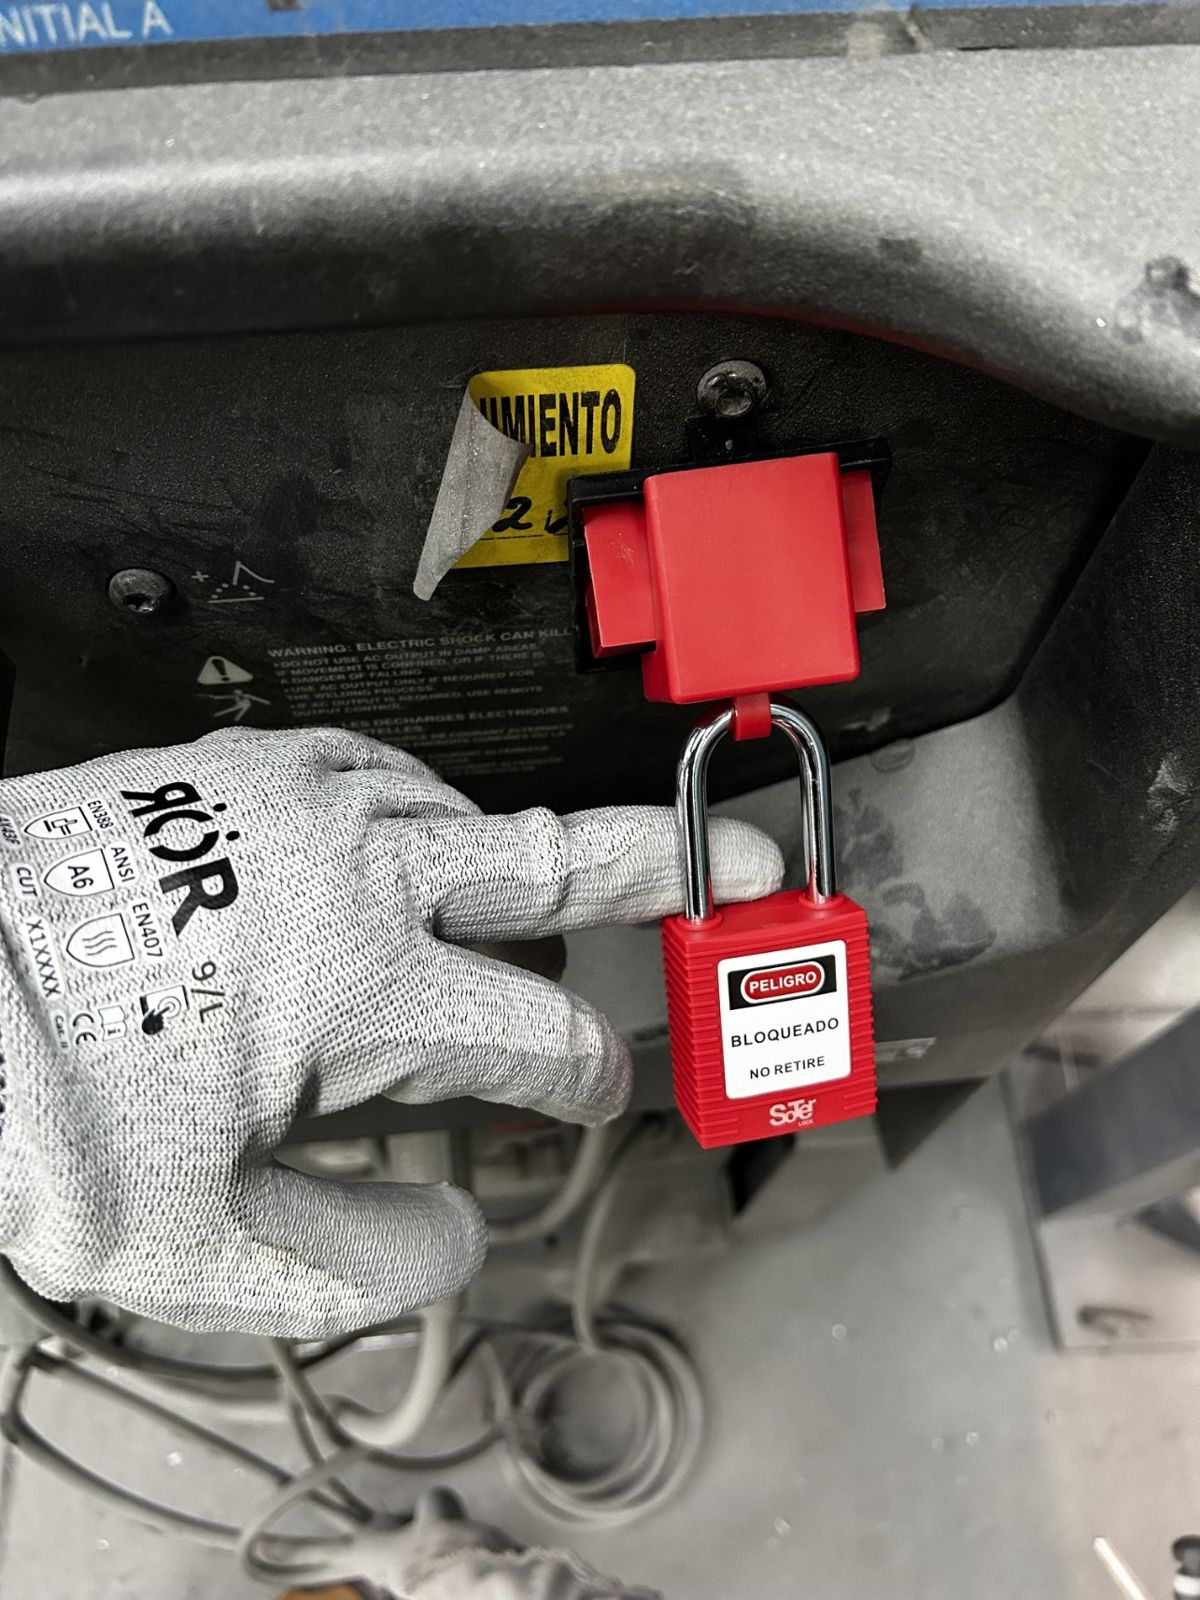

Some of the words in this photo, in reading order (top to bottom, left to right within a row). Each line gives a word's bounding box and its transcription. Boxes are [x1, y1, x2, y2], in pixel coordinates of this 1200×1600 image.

[268, 644, 350, 658] WARNING:
[356, 637, 435, 652] ELECTRIC
[440, 633, 496, 646] SHOCK
[500, 631, 534, 642] CAN
[303, 658, 329, 666] NOT
[333, 655, 360, 664] USE
[363, 654, 381, 662] AC
[384, 650, 435, 661] OUTPUT
[440, 649, 451, 657] IN
[455, 646, 492, 656] DAMP
[290, 664, 363, 676] MOVEMENT
[366, 663, 379, 671] IS
[452, 656, 471, 665] OR
[474, 655, 485, 663] IF
[489, 651, 529, 661] THERE
[532, 651, 545, 659] IS
[292, 674, 346, 684] DANGER
[349, 672, 366, 680] OF
[319, 683, 337, 691] AC
[340, 680, 390, 690] OUTPUT
[393, 677, 425, 686] ONLY
[428, 676, 440, 684] IF
[443, 672, 507, 683] REQUIRED
[509, 669, 535, 678] FOR
[286, 693, 310, 701] THE
[314, 689, 371, 699] WELDING
[332, 697, 380, 707] OUTPUT
[467, 689, 492, 698] USE
[494, 686, 544, 695] REMOTE
[292, 707, 341, 717] OUTPUT
[88, 800, 114, 829] EN388
[111, 847, 135, 882] ANSI
[17, 867, 38, 897] CUT
[67, 866, 94, 889] A6
[132, 902, 163, 958] EN407
[26, 919, 61, 997] X1XXXX
[749, 971, 817, 994] PELIGRO
[731, 1017, 839, 1048] BLOQUEADO
[750, 1066, 771, 1079] NO
[774, 1056, 825, 1076] RETIRE
